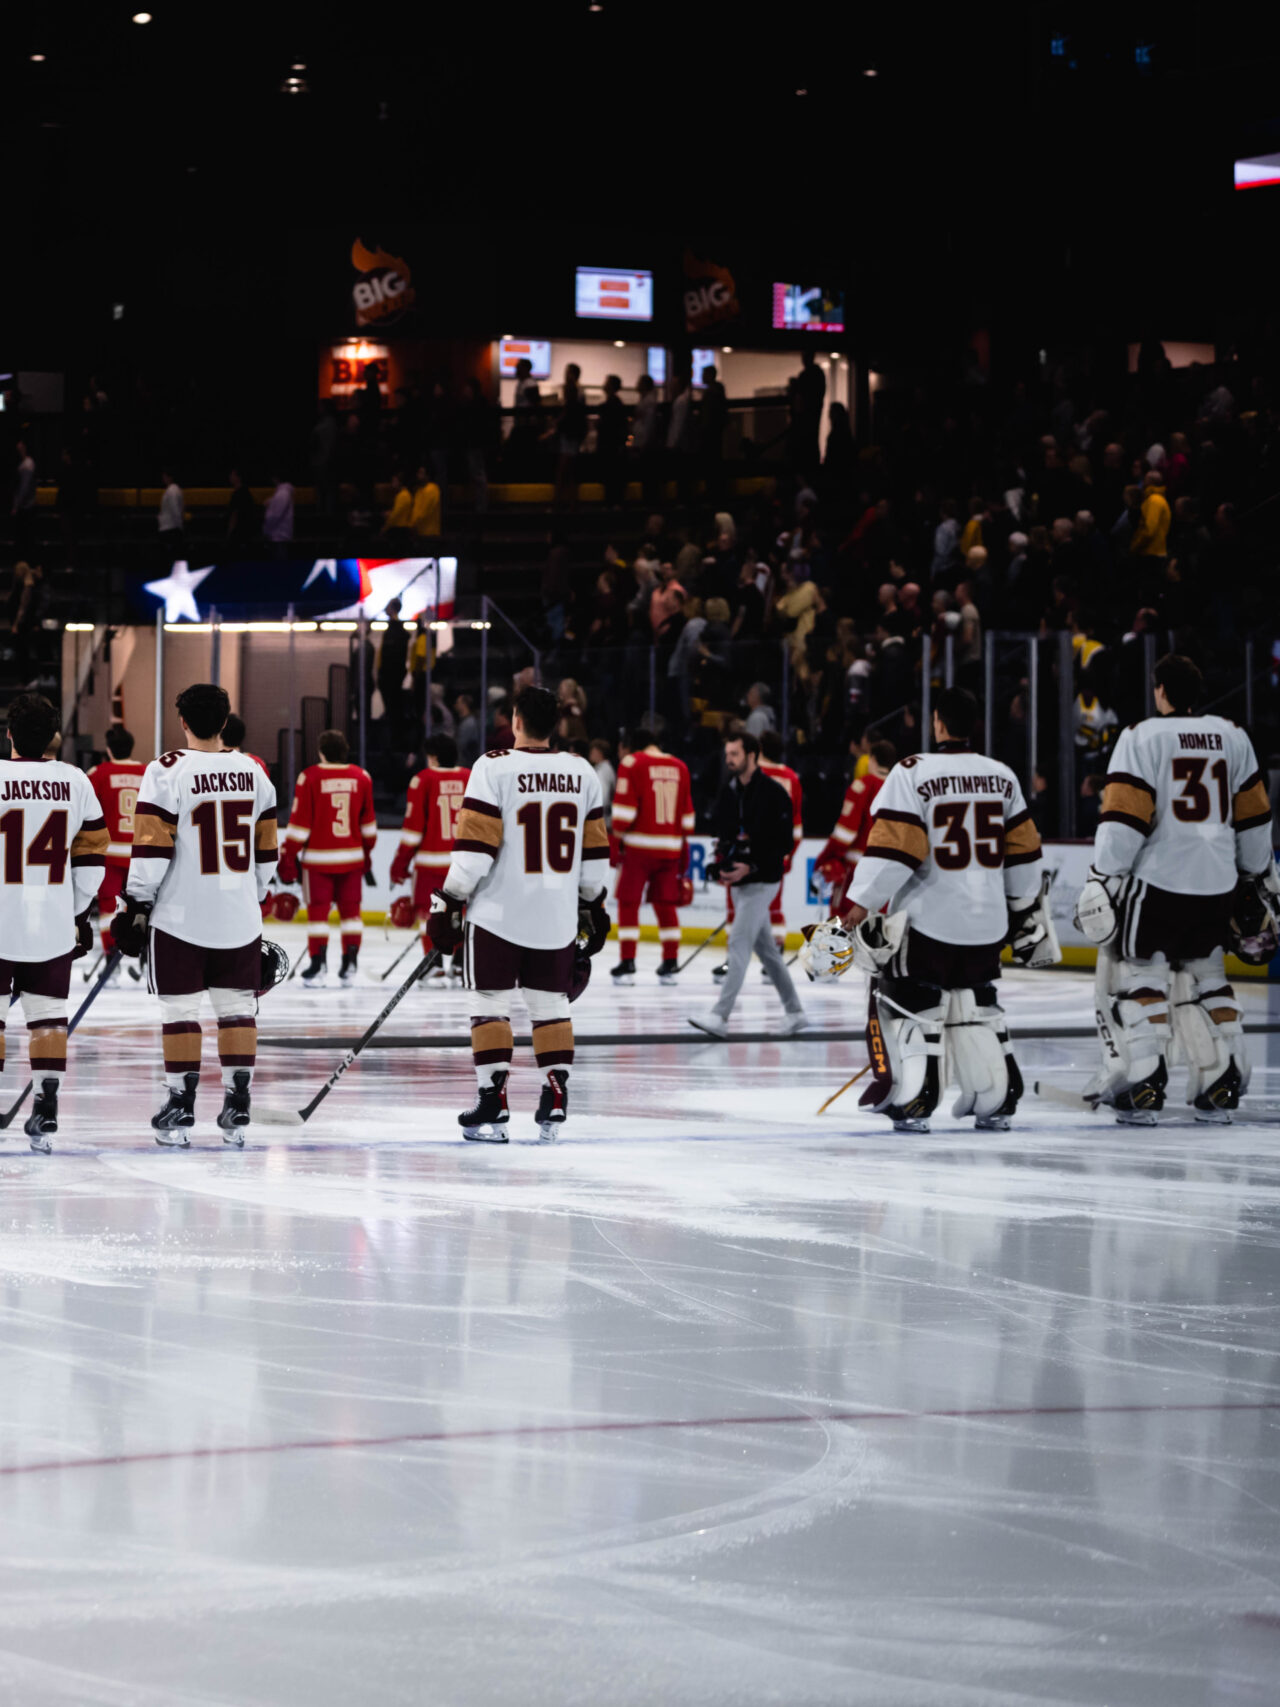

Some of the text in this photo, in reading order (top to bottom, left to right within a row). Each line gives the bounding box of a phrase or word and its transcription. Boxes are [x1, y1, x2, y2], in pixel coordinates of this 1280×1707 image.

[352, 271, 407, 311] BIG
[683, 281, 730, 318] BIG
[1178, 733, 1223, 751] HOMER
[1, 780, 71, 802] JACKSON
[191, 771, 254, 795] JACKSON
[517, 773, 582, 794] SZMAGAJ
[1172, 756, 1228, 823] 31
[118, 788, 139, 833] 9
[330, 791, 352, 838] 3
[0, 808, 69, 885] 14
[191, 800, 255, 875] 15
[517, 802, 578, 874] 16
[932, 801, 1005, 872] 35
[869, 1019, 887, 1073] CCM
[1096, 1009, 1120, 1058] CCM
